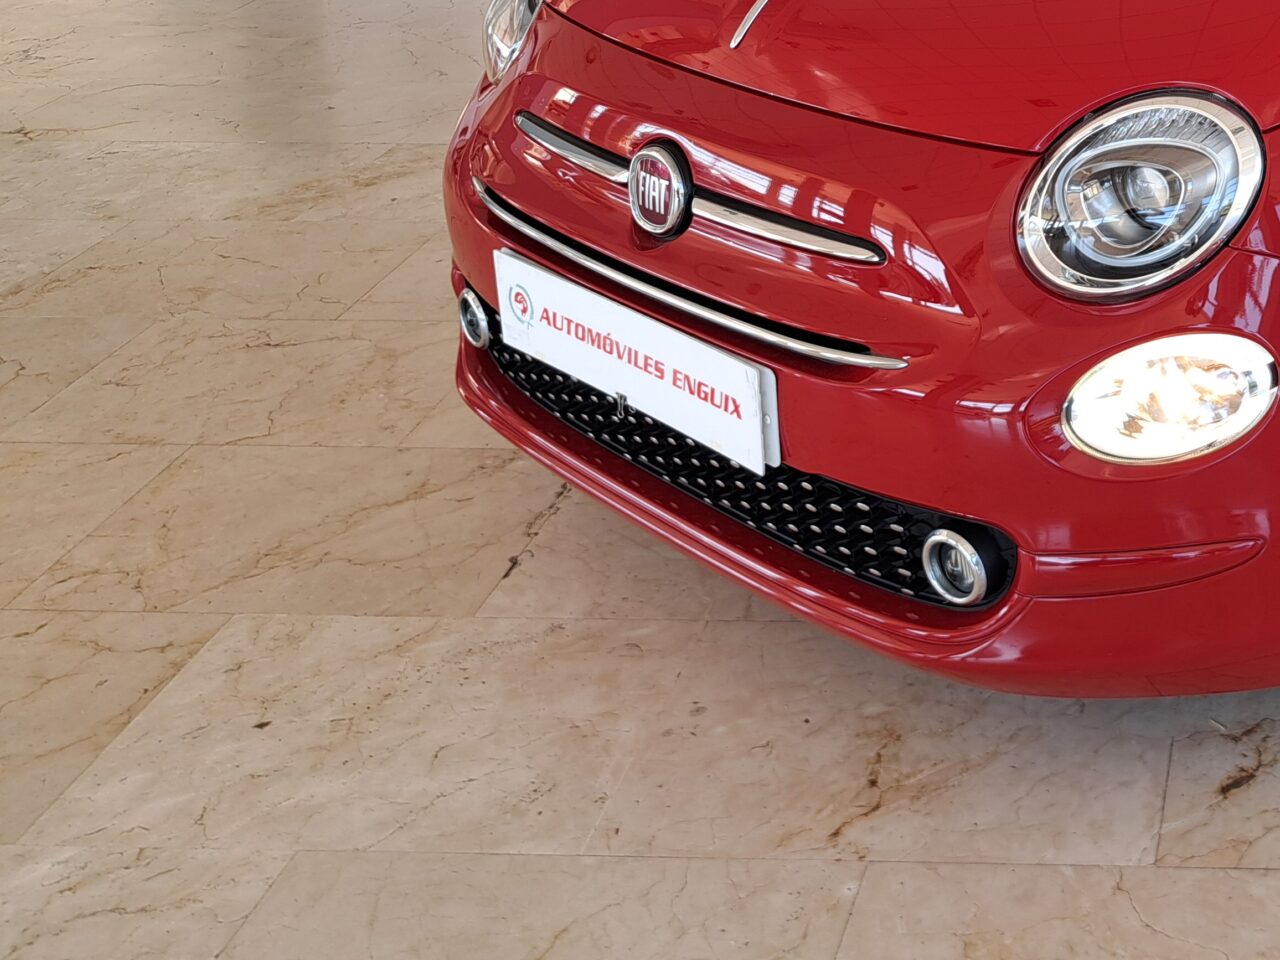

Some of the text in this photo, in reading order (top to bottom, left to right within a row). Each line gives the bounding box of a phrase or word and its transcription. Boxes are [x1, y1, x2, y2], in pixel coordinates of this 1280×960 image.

[638, 171, 669, 215] FIAT
[539, 307, 743, 421] AUTOMÓVILES ENGUIX
